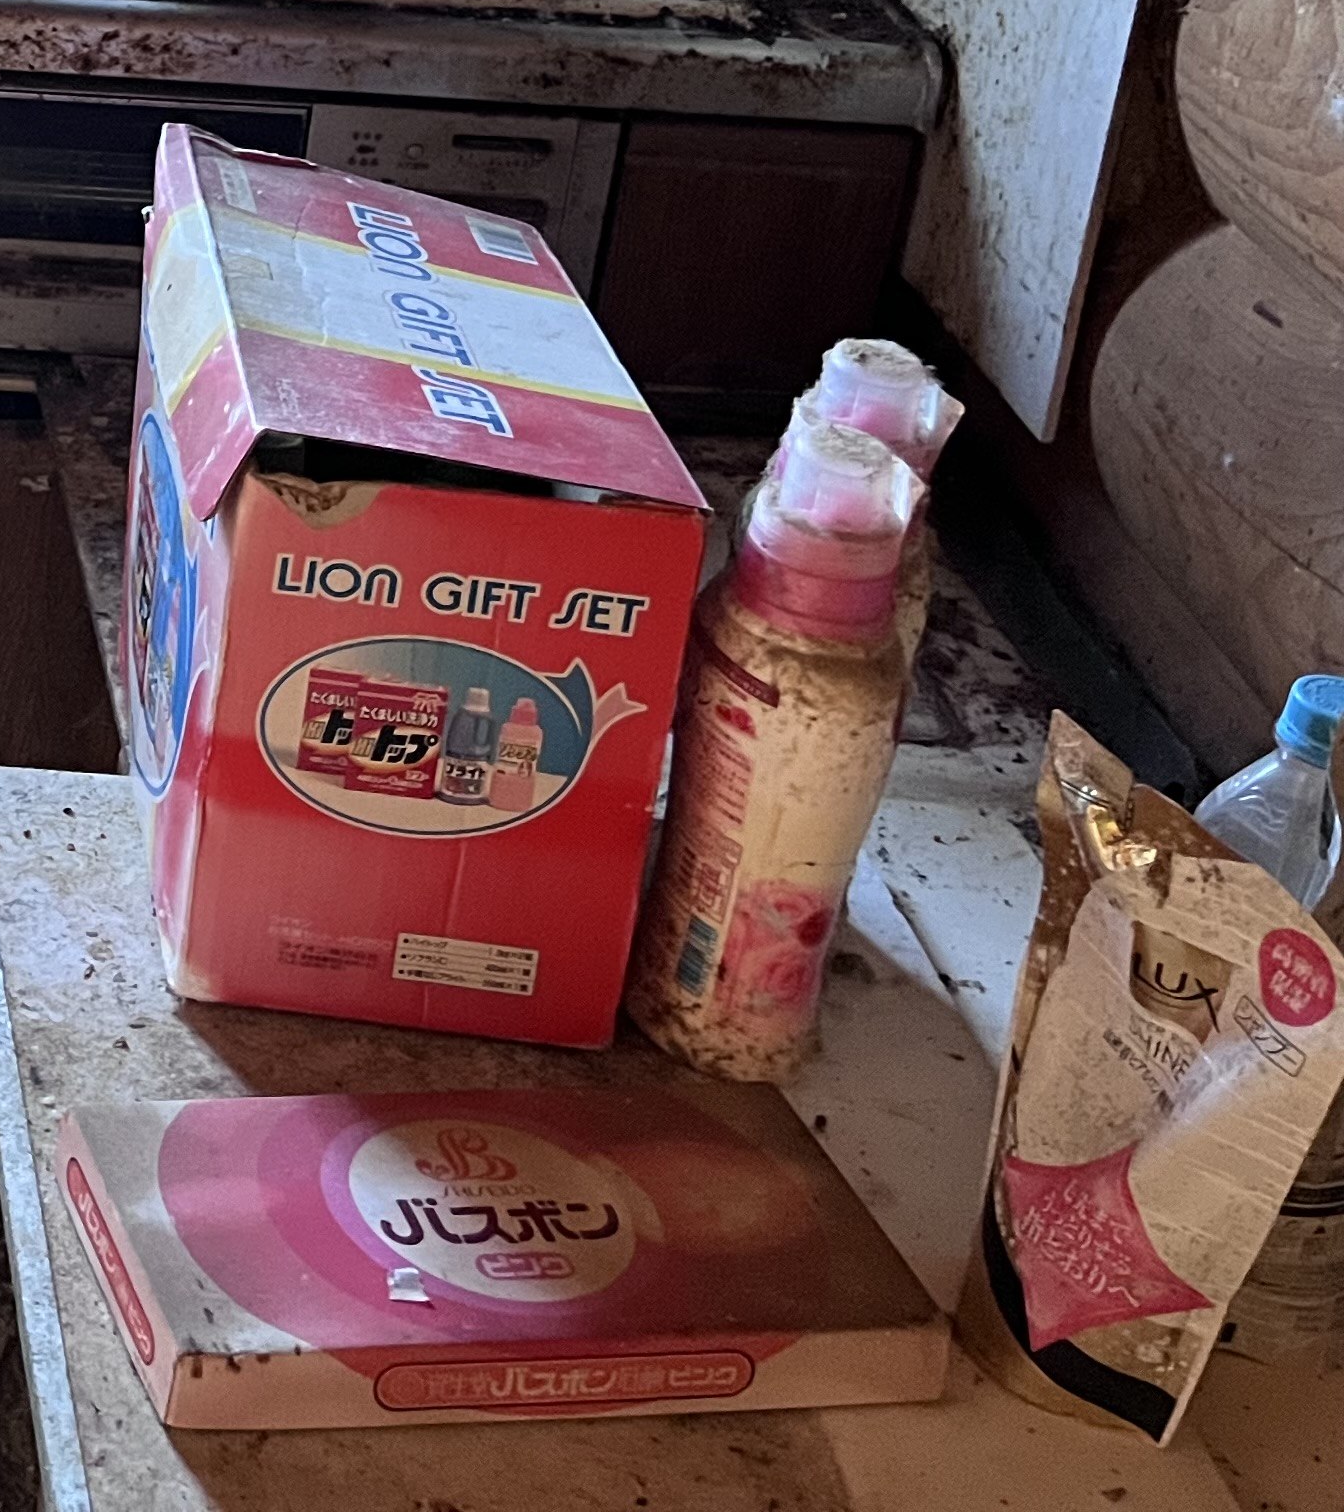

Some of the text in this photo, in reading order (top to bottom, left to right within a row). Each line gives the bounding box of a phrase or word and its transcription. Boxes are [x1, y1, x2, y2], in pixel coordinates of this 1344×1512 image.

[351, 203, 508, 435] LION GIFT SET
[275, 556, 646, 635] LION GIFT SET
[370, 723, 440, 765] トップ
[1131, 951, 1222, 1035] LUX
[380, 1197, 620, 1247] バスボン
[480, 1253, 575, 1278] ピンク
